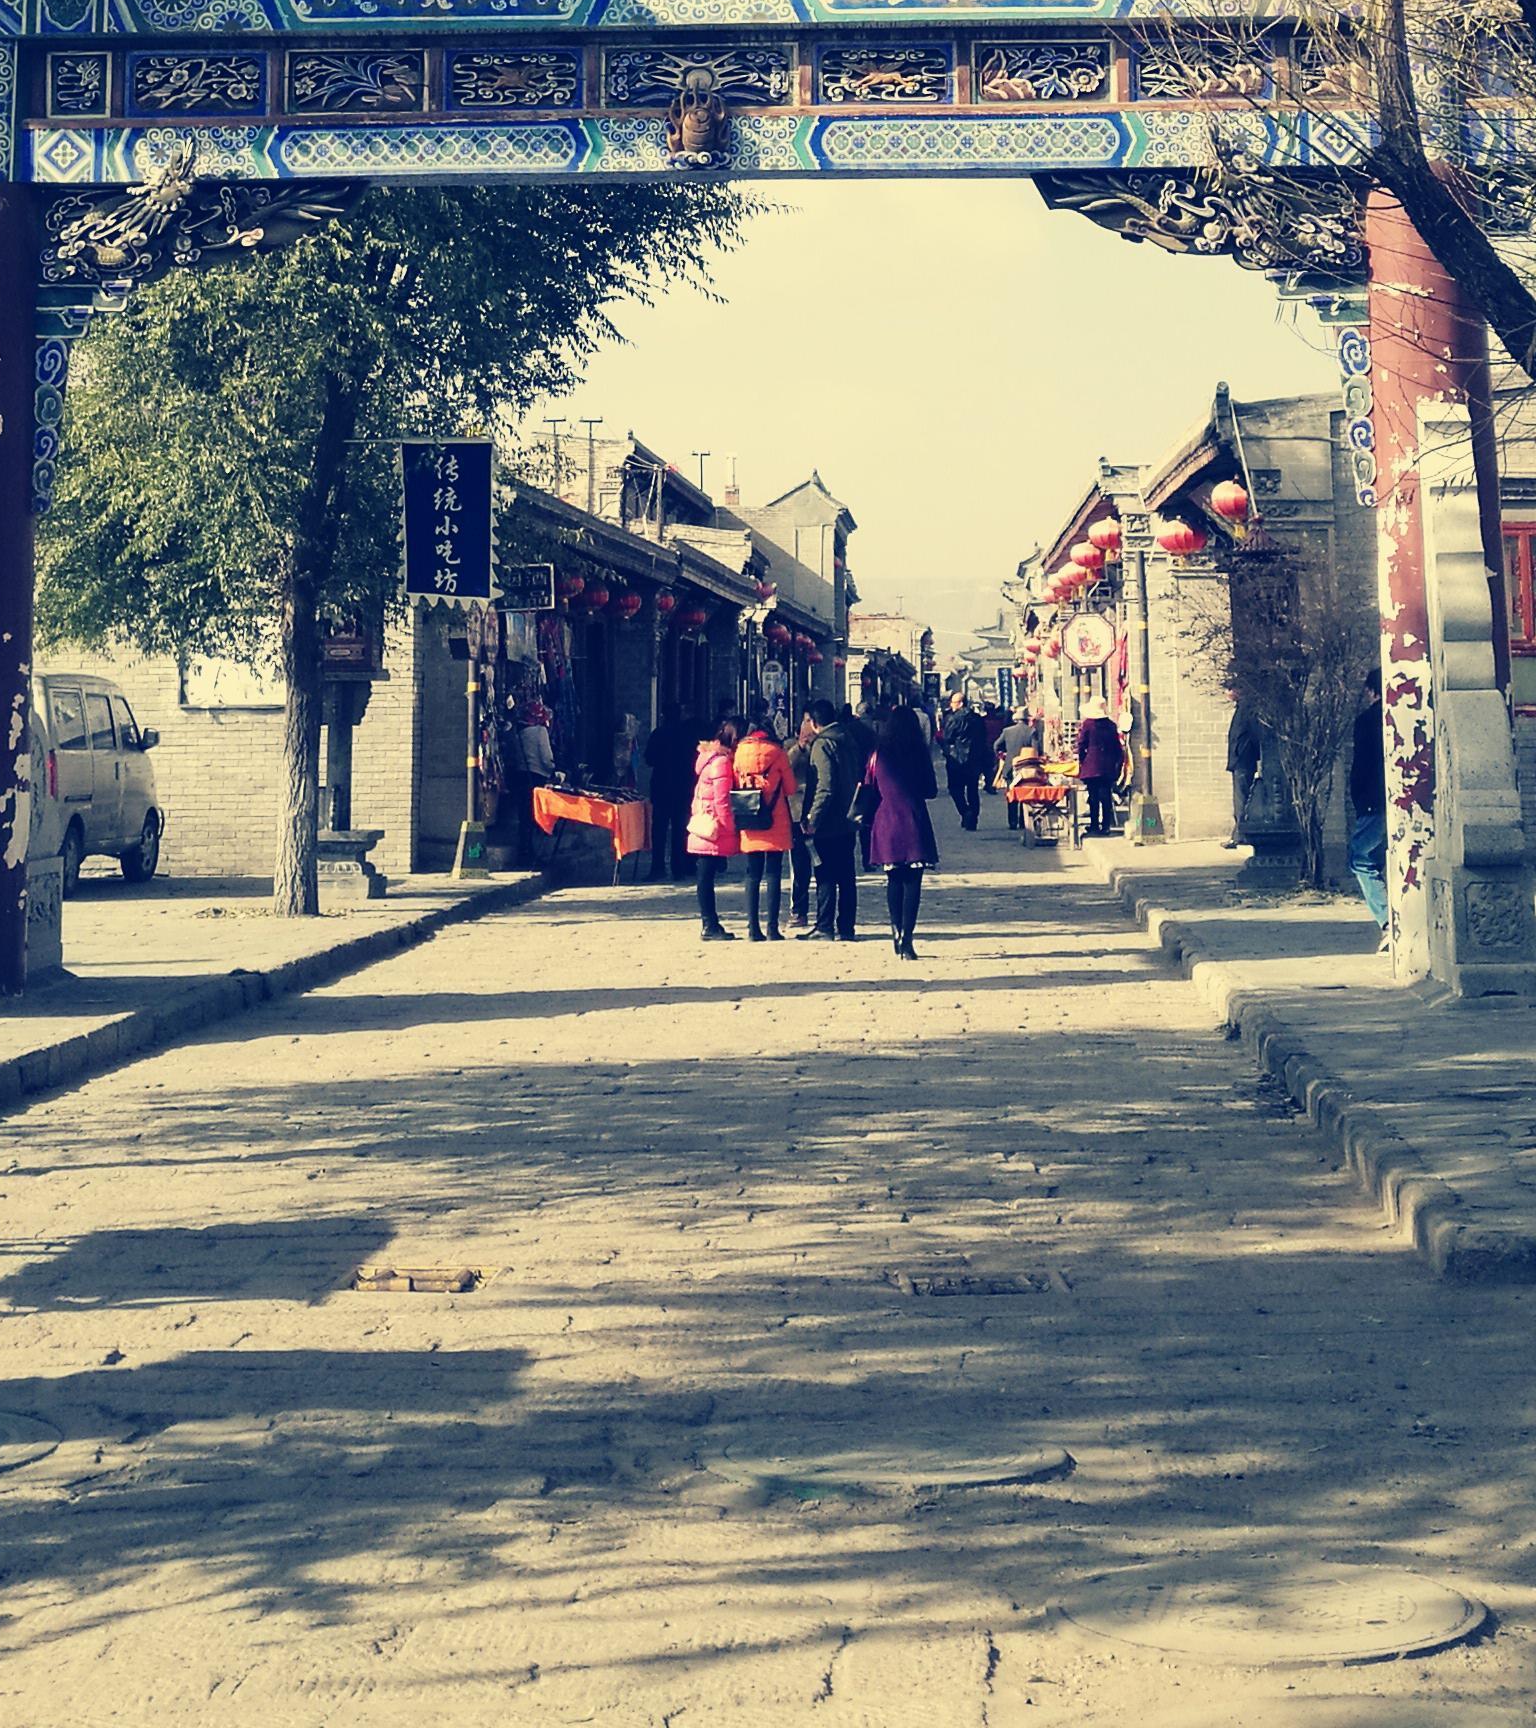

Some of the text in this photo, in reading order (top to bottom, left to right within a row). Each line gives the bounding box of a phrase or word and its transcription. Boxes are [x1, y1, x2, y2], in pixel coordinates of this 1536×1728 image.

[433, 454, 463, 593] 传统小吃坊
